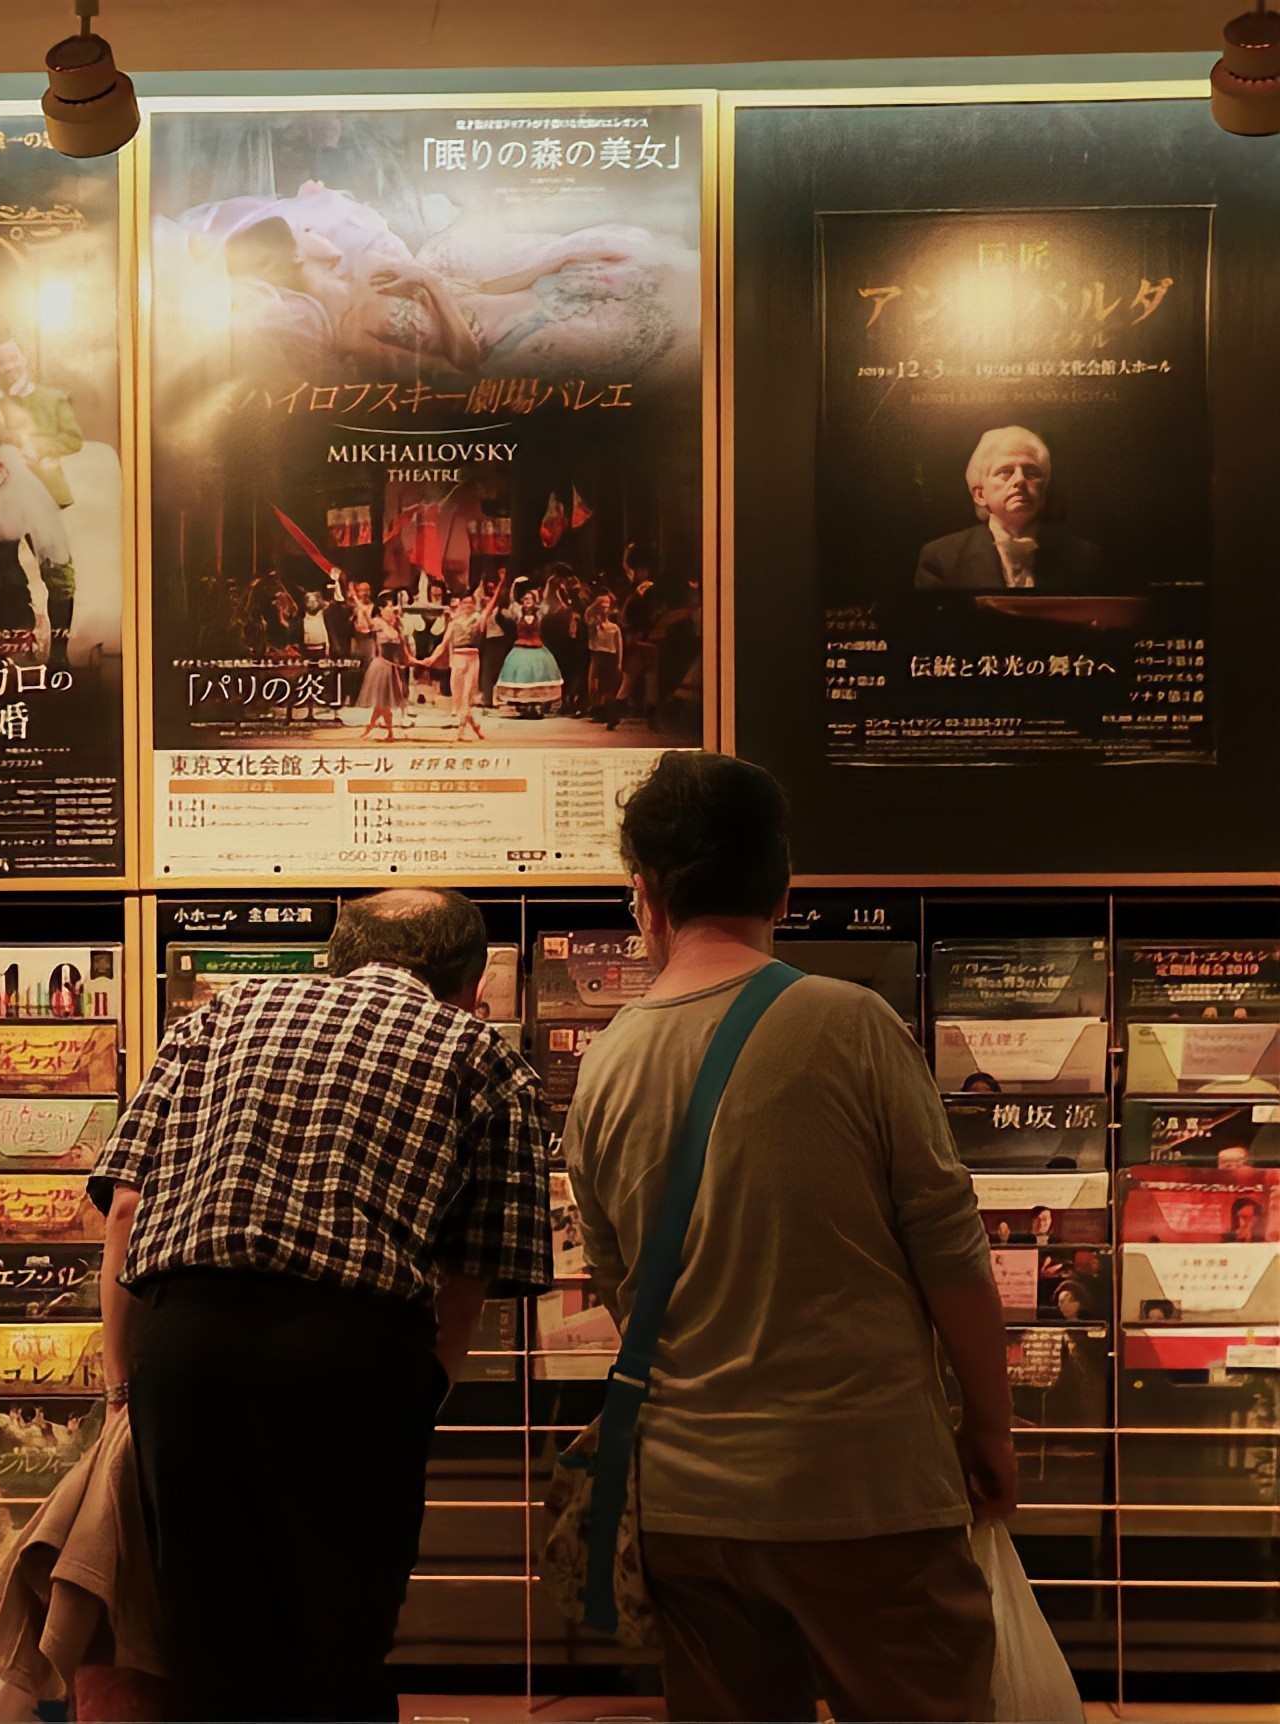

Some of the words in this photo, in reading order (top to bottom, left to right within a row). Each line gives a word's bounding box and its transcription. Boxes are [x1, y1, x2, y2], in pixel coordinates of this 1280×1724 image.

[423, 135, 680, 172] 「眠りの森の美女」
[225, 376, 635, 415] ハイロフスキー劇場バレエ
[326, 443, 520, 463] MIKHAILOVSKY
[387, 468, 461, 483] THEATRE
[910, 655, 1117, 678] 伝統と栄光の舞台へ
[188, 672, 343, 707] 「パリの炎」
[170, 755, 303, 777] 東京文化会館
[311, 755, 394, 775] 大ホール
